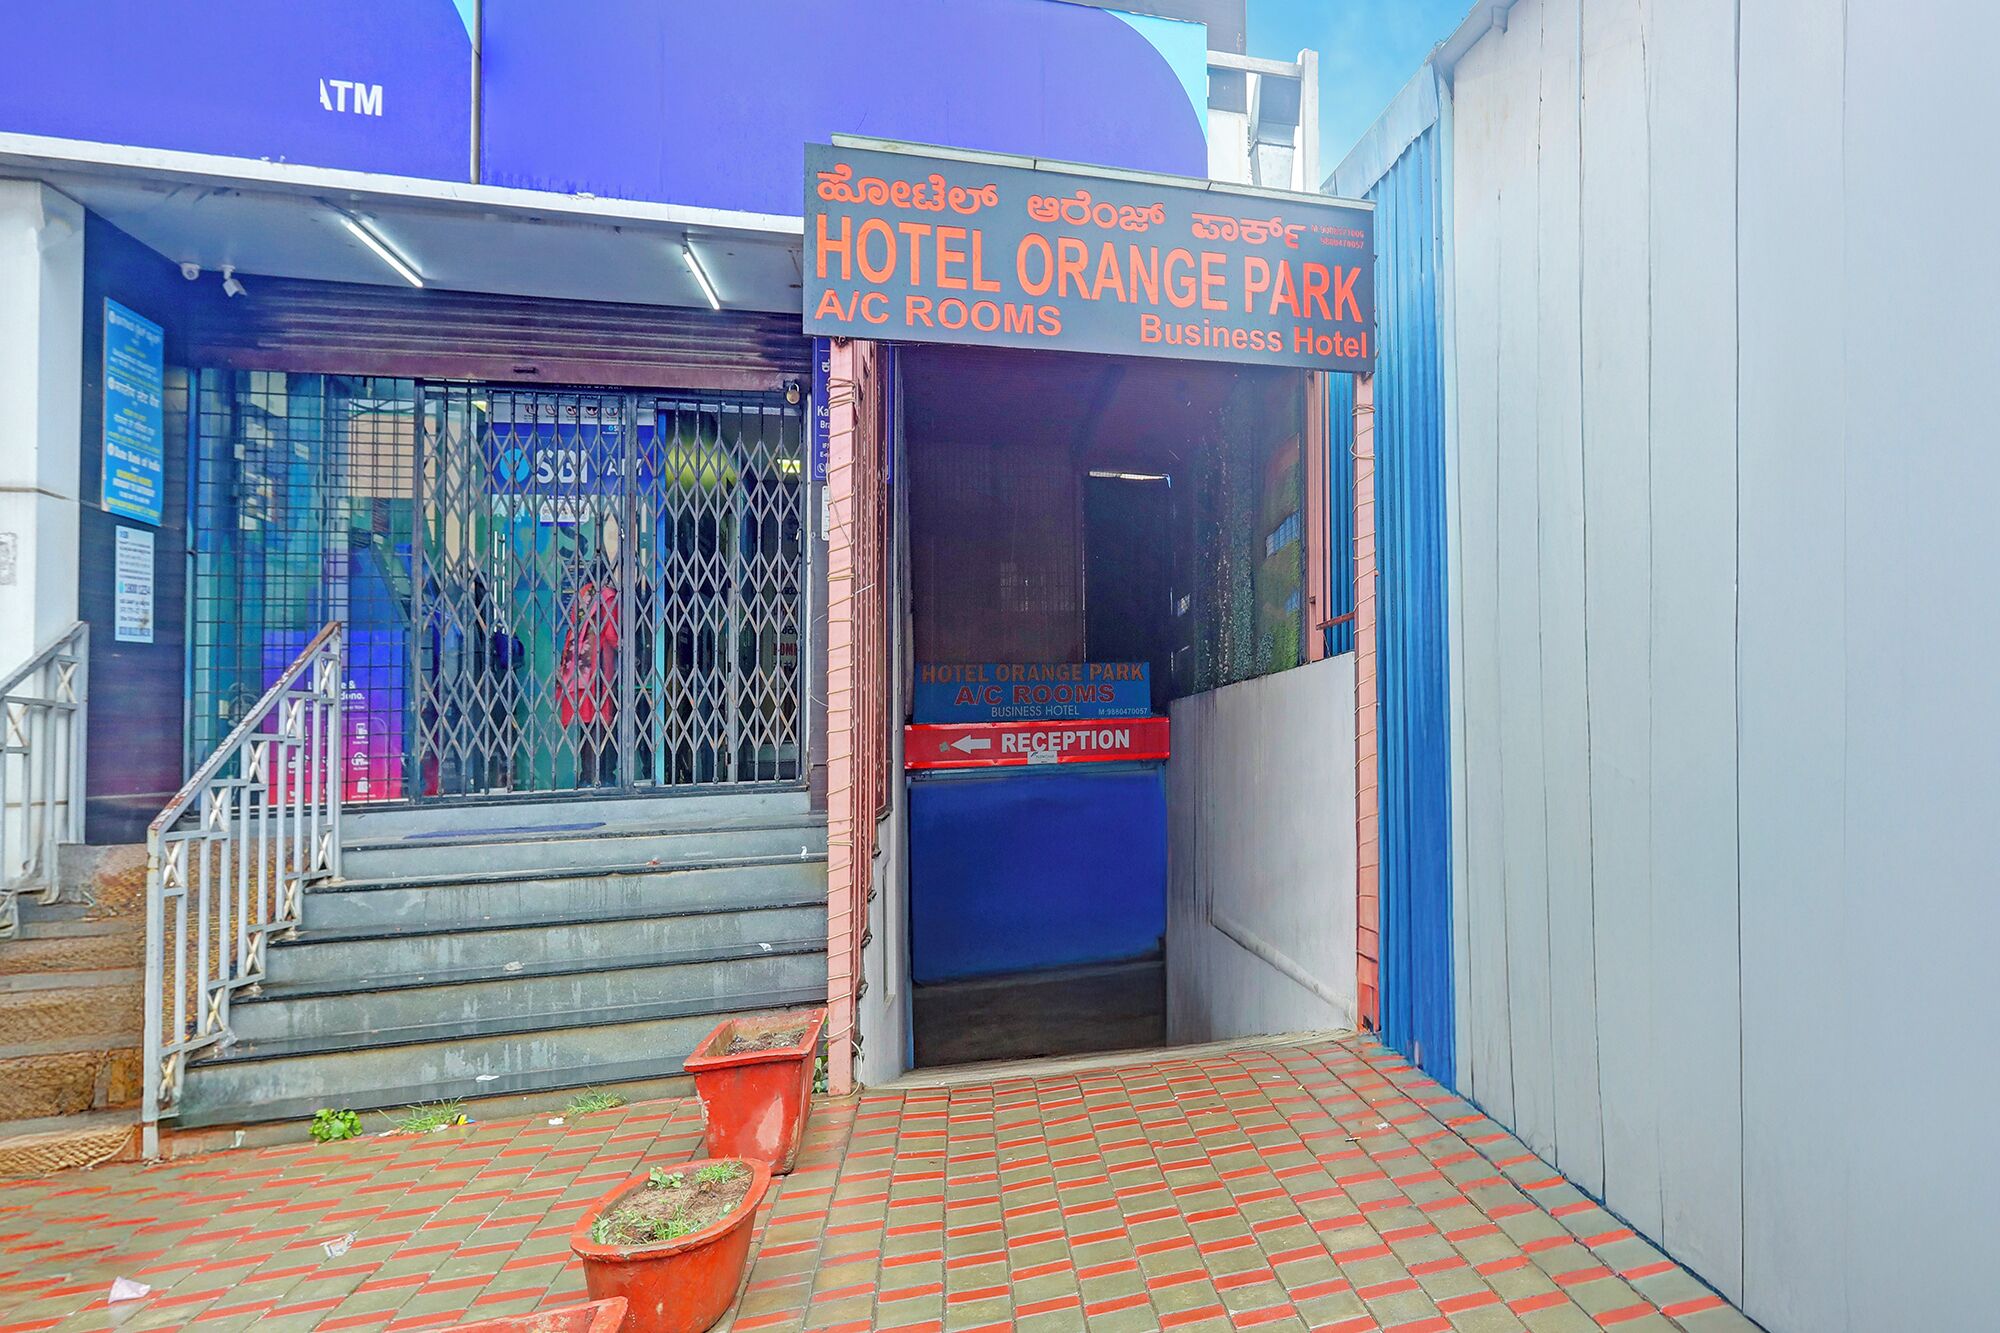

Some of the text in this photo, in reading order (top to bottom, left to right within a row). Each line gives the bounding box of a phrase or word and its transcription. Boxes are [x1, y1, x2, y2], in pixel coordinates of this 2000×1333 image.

[817, 164, 1305, 249] ಹೋಟೆಲ್ ಆರೆಂಜ್ ಪಾರ್ಕ್
[817, 214, 1363, 324] HOTEL ORANGE PARK
[815, 288, 1062, 337] A/C ROOMS
[1140, 313, 1368, 359] Business Hotel
[537, 449, 588, 484] SBI
[922, 663, 1144, 684] HOTEL ORANGE PARK
[954, 684, 1116, 705] A/C ROOMS
[991, 705, 1080, 718] BUSINESS HOTEL
[1001, 729, 1130, 753] RECEPTION
